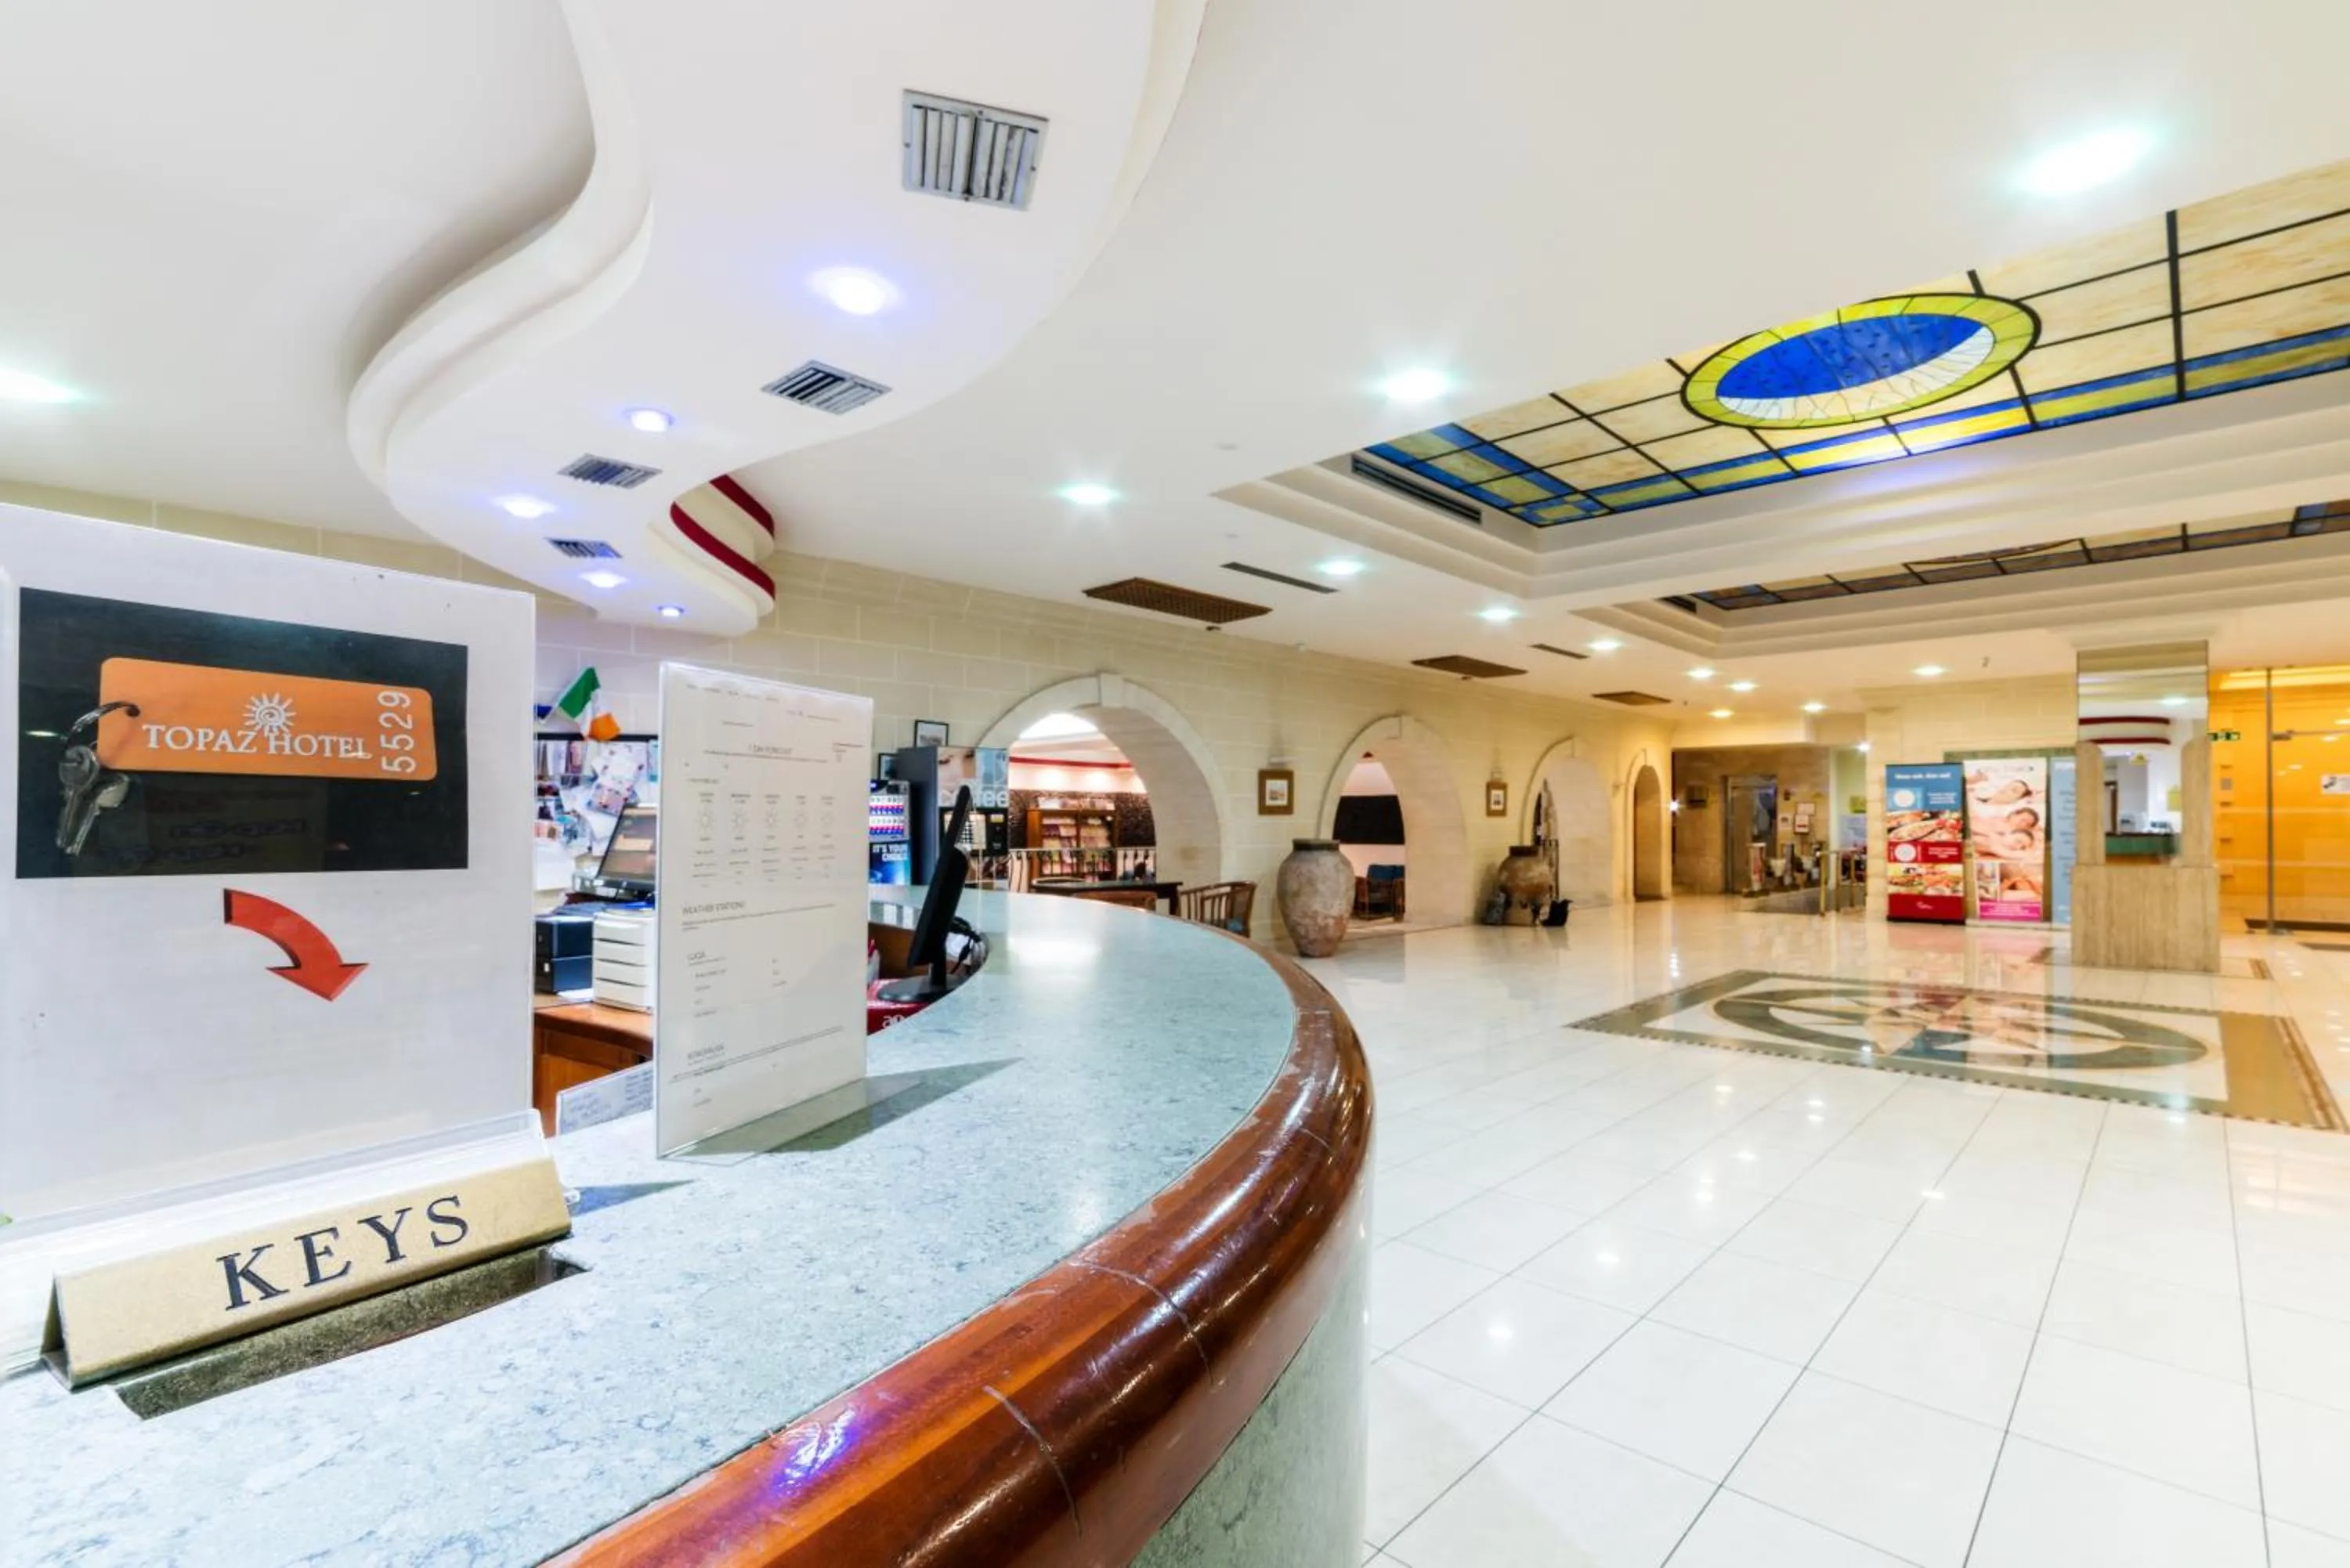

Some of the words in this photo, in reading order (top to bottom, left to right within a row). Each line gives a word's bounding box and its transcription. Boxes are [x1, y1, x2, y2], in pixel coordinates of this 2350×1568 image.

[142, 723, 258, 753] TOPAZ
[266, 725, 372, 760] HOTEL
[377, 690, 417, 774] 5529
[216, 1194, 469, 1311] KEYS
